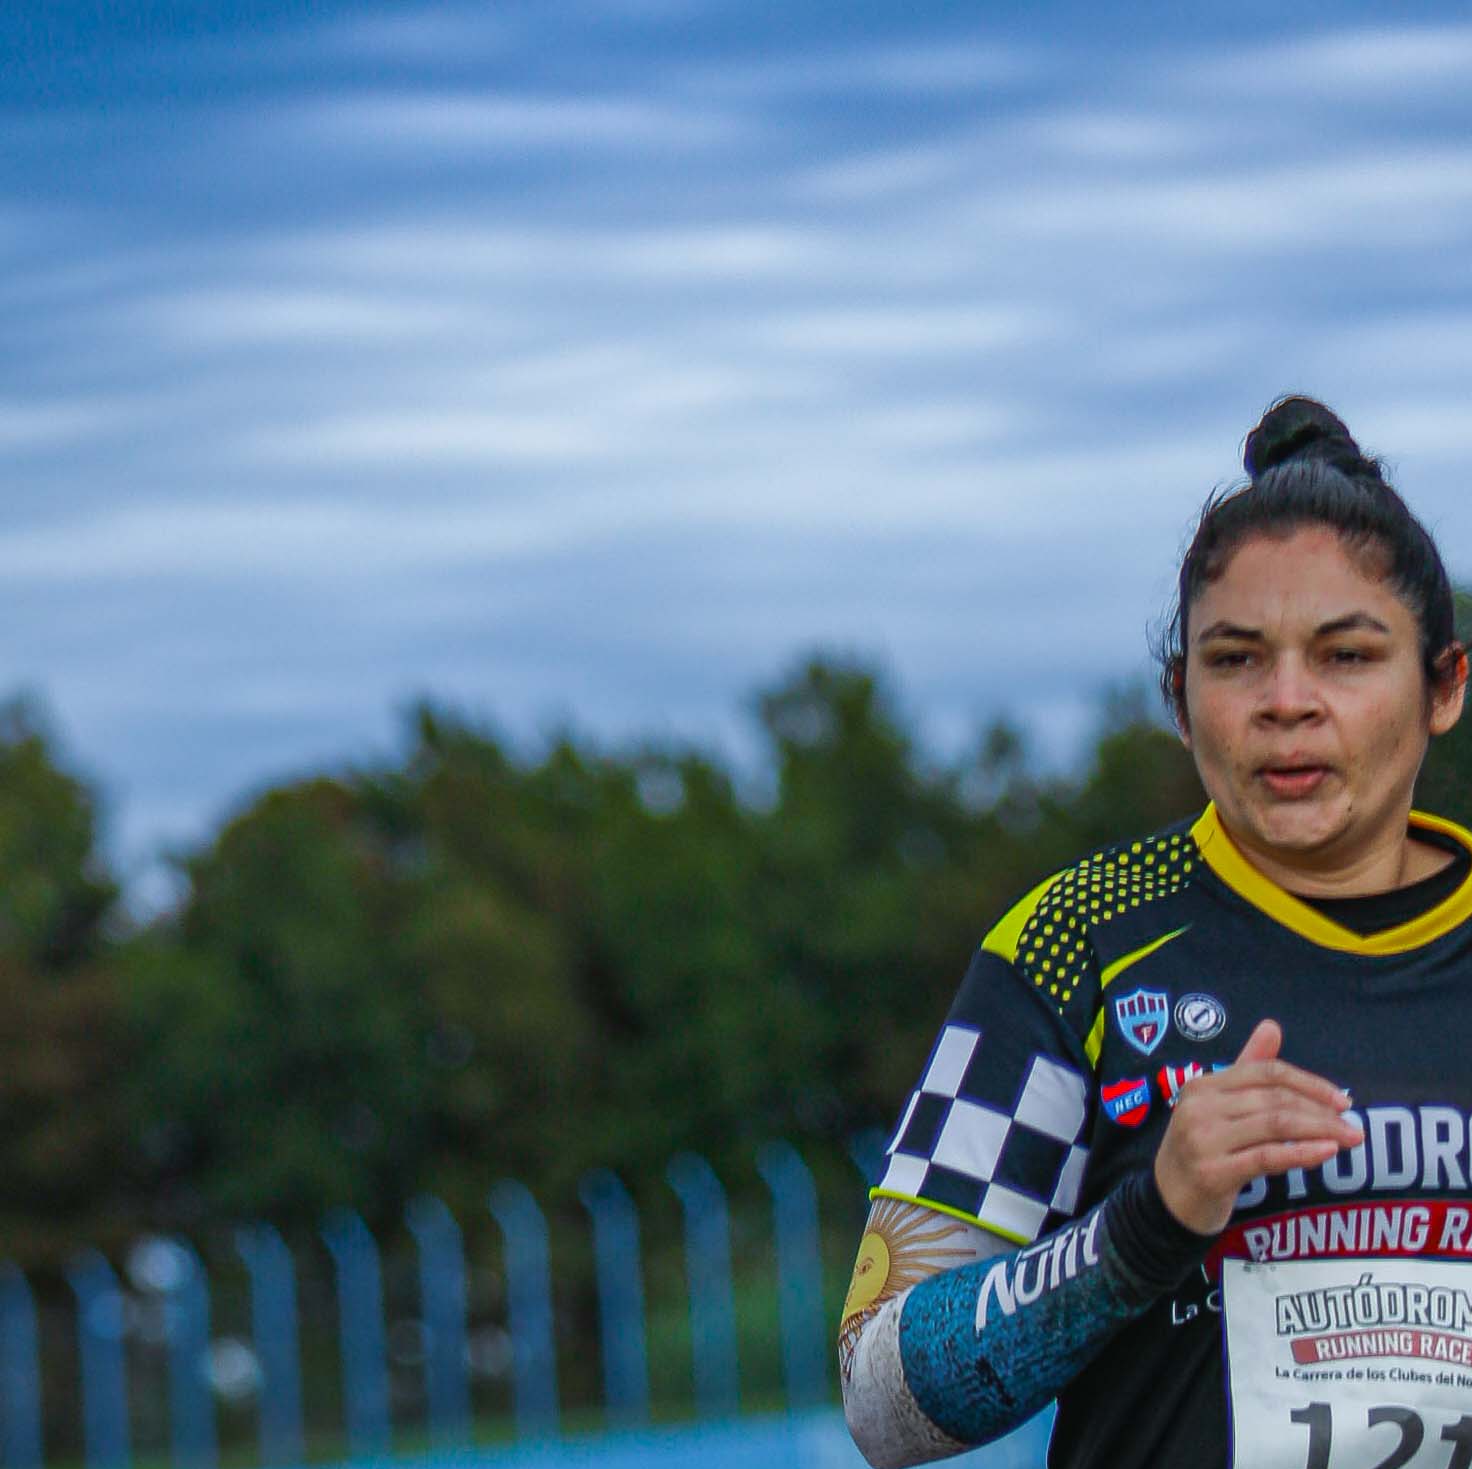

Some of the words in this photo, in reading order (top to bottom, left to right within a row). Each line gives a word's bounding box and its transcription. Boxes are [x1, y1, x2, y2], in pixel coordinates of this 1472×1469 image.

[1243, 1206, 1430, 1262] RUNNING
[1172, 1303, 1198, 1326] La
[1315, 1332, 1413, 1361] RUNNING
[1275, 1365, 1290, 1378] La
[1293, 1367, 1342, 1382] Carrera
[1346, 1367, 1363, 1380] de
[1366, 1367, 1386, 1382] los
[1389, 1367, 1433, 1384] Clubes
[1435, 1371, 1454, 1386] del
